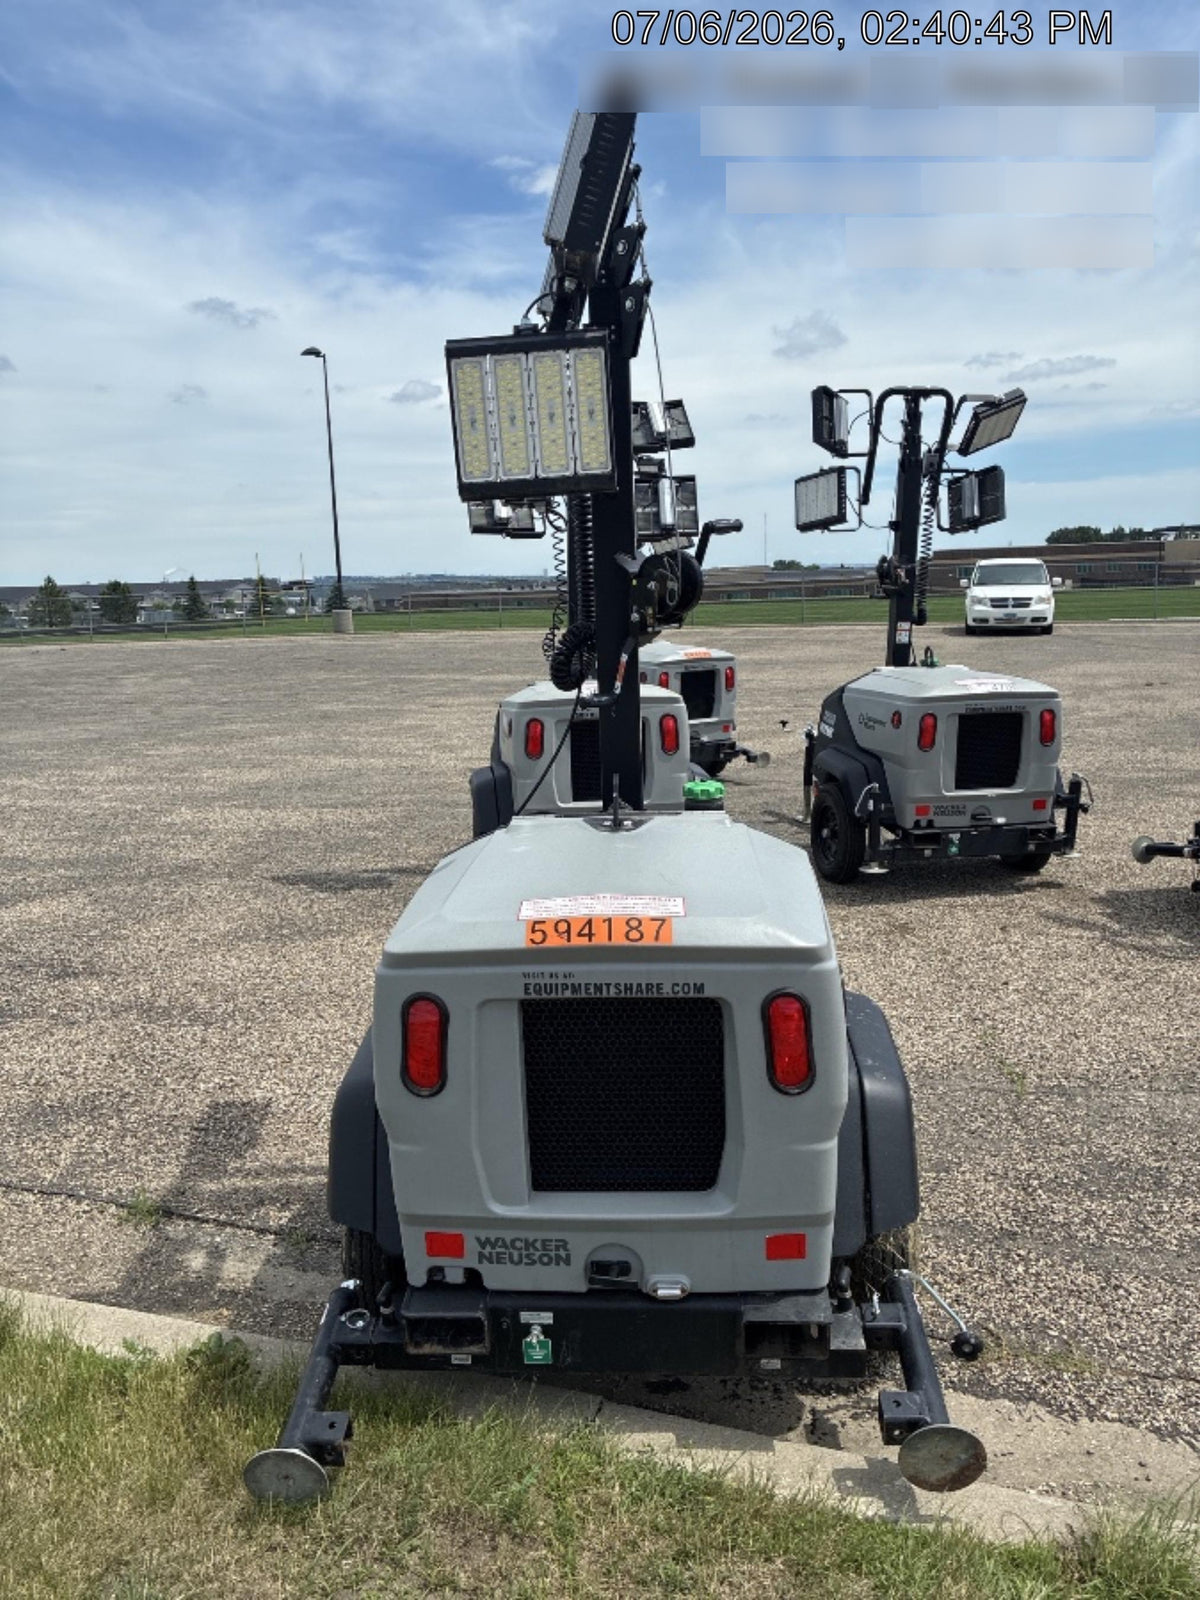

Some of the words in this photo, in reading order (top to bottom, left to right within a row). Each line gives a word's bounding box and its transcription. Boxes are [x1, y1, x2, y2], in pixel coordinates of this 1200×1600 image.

[529, 917, 667, 945] 594187
[523, 982, 705, 996] EQUIPMENTSHARE.COM
[475, 1236, 569, 1252] WACKER
[478, 1251, 571, 1266] NEUSON
